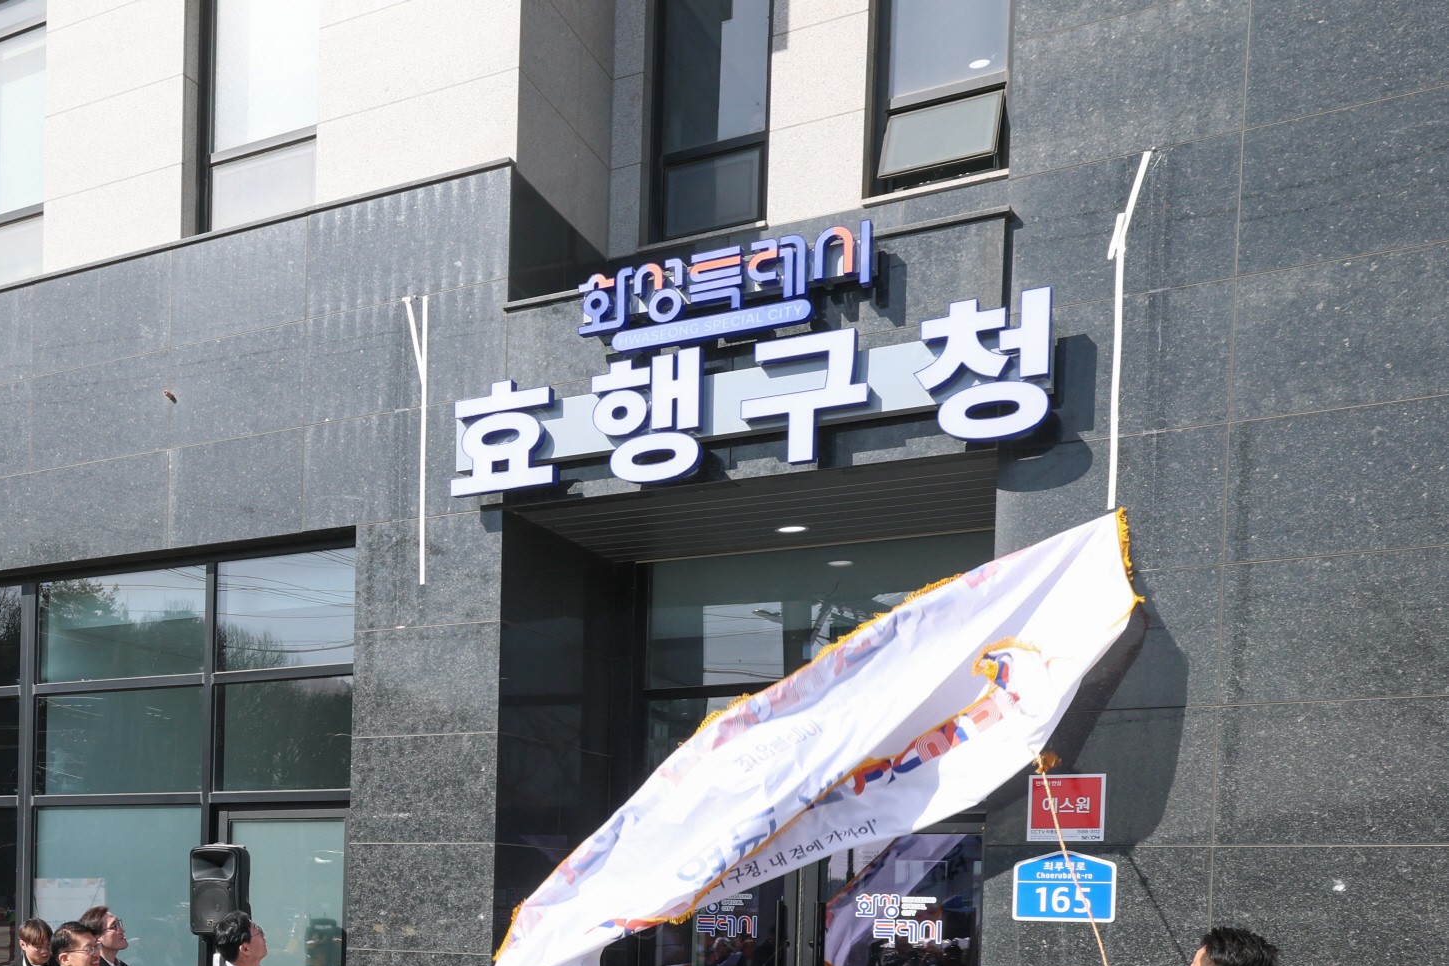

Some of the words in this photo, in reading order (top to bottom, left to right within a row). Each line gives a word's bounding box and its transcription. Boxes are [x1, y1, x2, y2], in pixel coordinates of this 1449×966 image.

[577, 218, 873, 336] 화성특례시
[618, 323, 700, 347] HWASEONG
[702, 311, 764, 332] SPECIAL
[767, 304, 803, 322] CITY
[450, 287, 1052, 497] 효행구청
[1042, 796, 1091, 814] 에스원
[769, 852, 788, 868] 내
[791, 839, 825, 860] 곁에
[855, 893, 901, 918] 화성
[1035, 886, 1092, 913] 165
[696, 914, 757, 938] 특례시
[873, 919, 943, 944] 특례시
